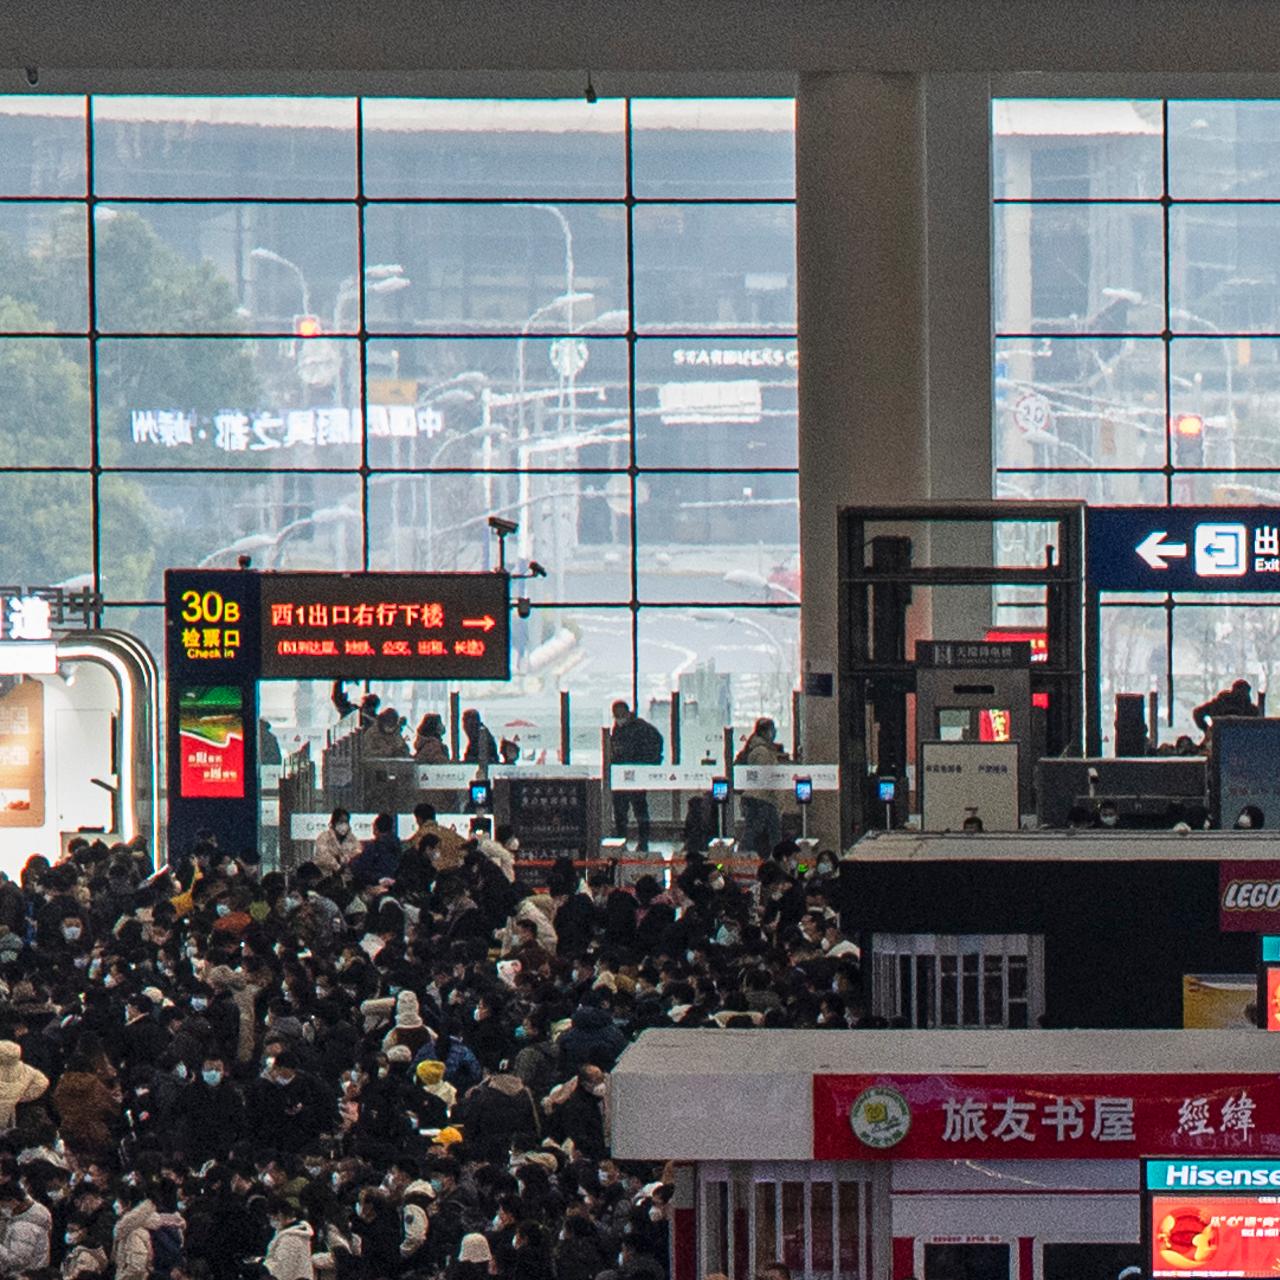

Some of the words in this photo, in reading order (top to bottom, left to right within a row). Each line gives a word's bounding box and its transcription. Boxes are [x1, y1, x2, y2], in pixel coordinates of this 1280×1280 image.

[1255, 558, 1280, 572] Exit
[181, 591, 240, 623] 30B
[271, 603, 443, 628] 西1出口右行下楼
[181, 629, 240, 648] 检票口
[942, 1096, 1136, 1142] 旅友书屋
[1176, 1091, 1257, 1141] 經緯
